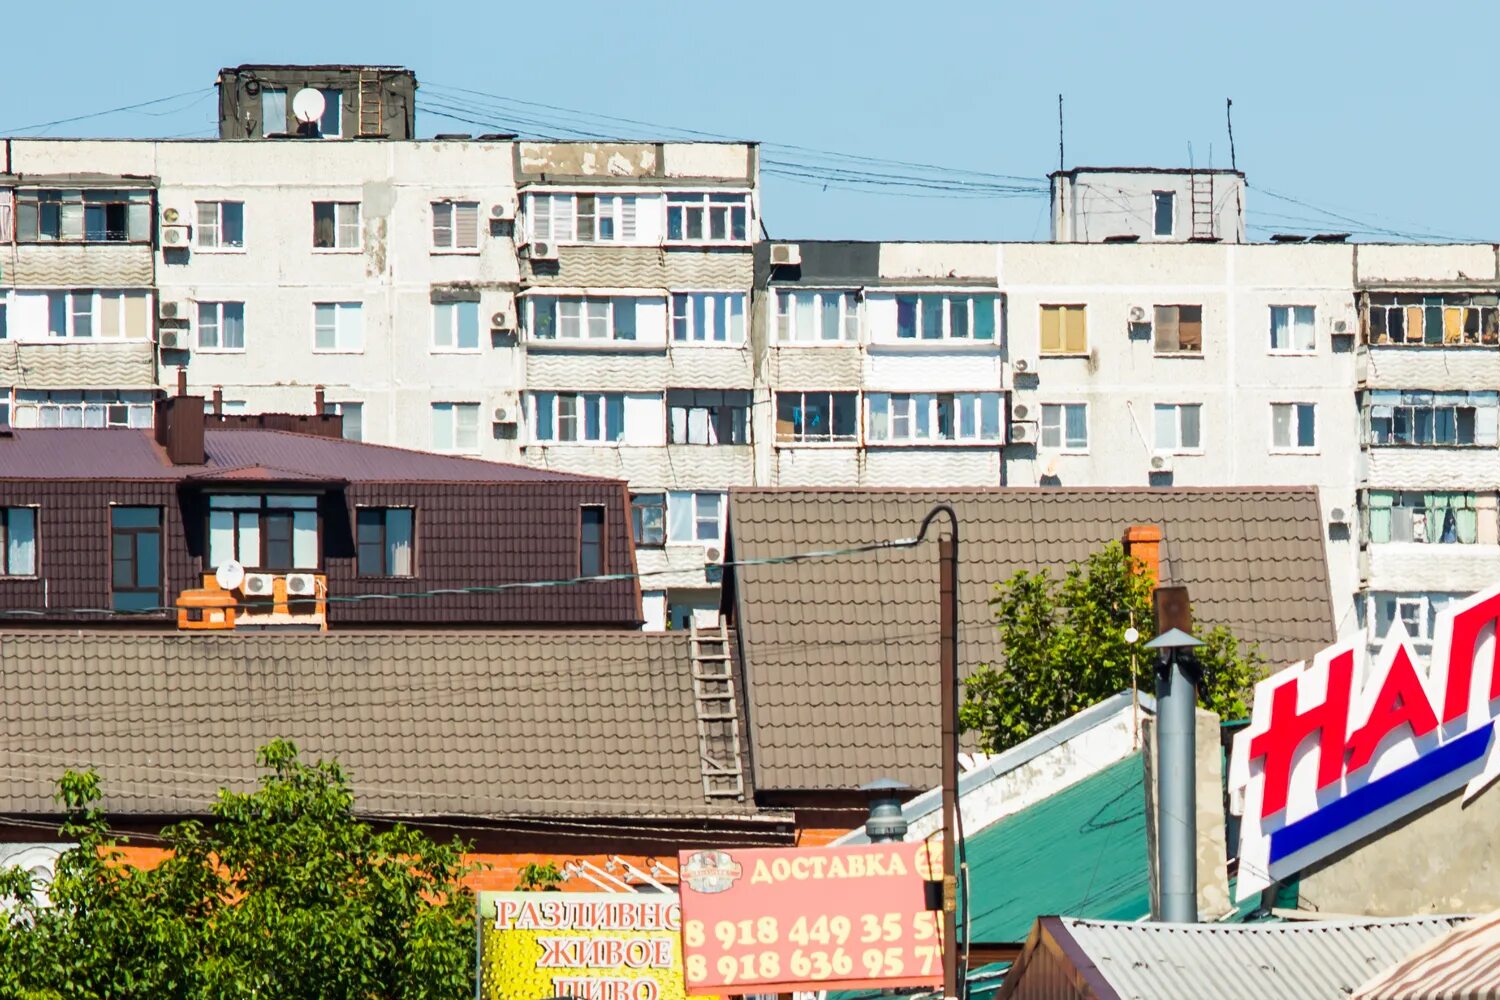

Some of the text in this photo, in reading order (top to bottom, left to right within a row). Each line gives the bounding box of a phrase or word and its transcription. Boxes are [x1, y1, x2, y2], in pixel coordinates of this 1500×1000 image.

[751, 852, 907, 884] ДОСТАВКА
[714, 916, 779, 950] 918
[789, 914, 851, 946] 449
[860, 912, 903, 943] 35
[537, 937, 673, 968] ЖИВОЕ
[716, 951, 781, 984] 918
[790, 948, 853, 980] 636
[862, 947, 904, 977] 95
